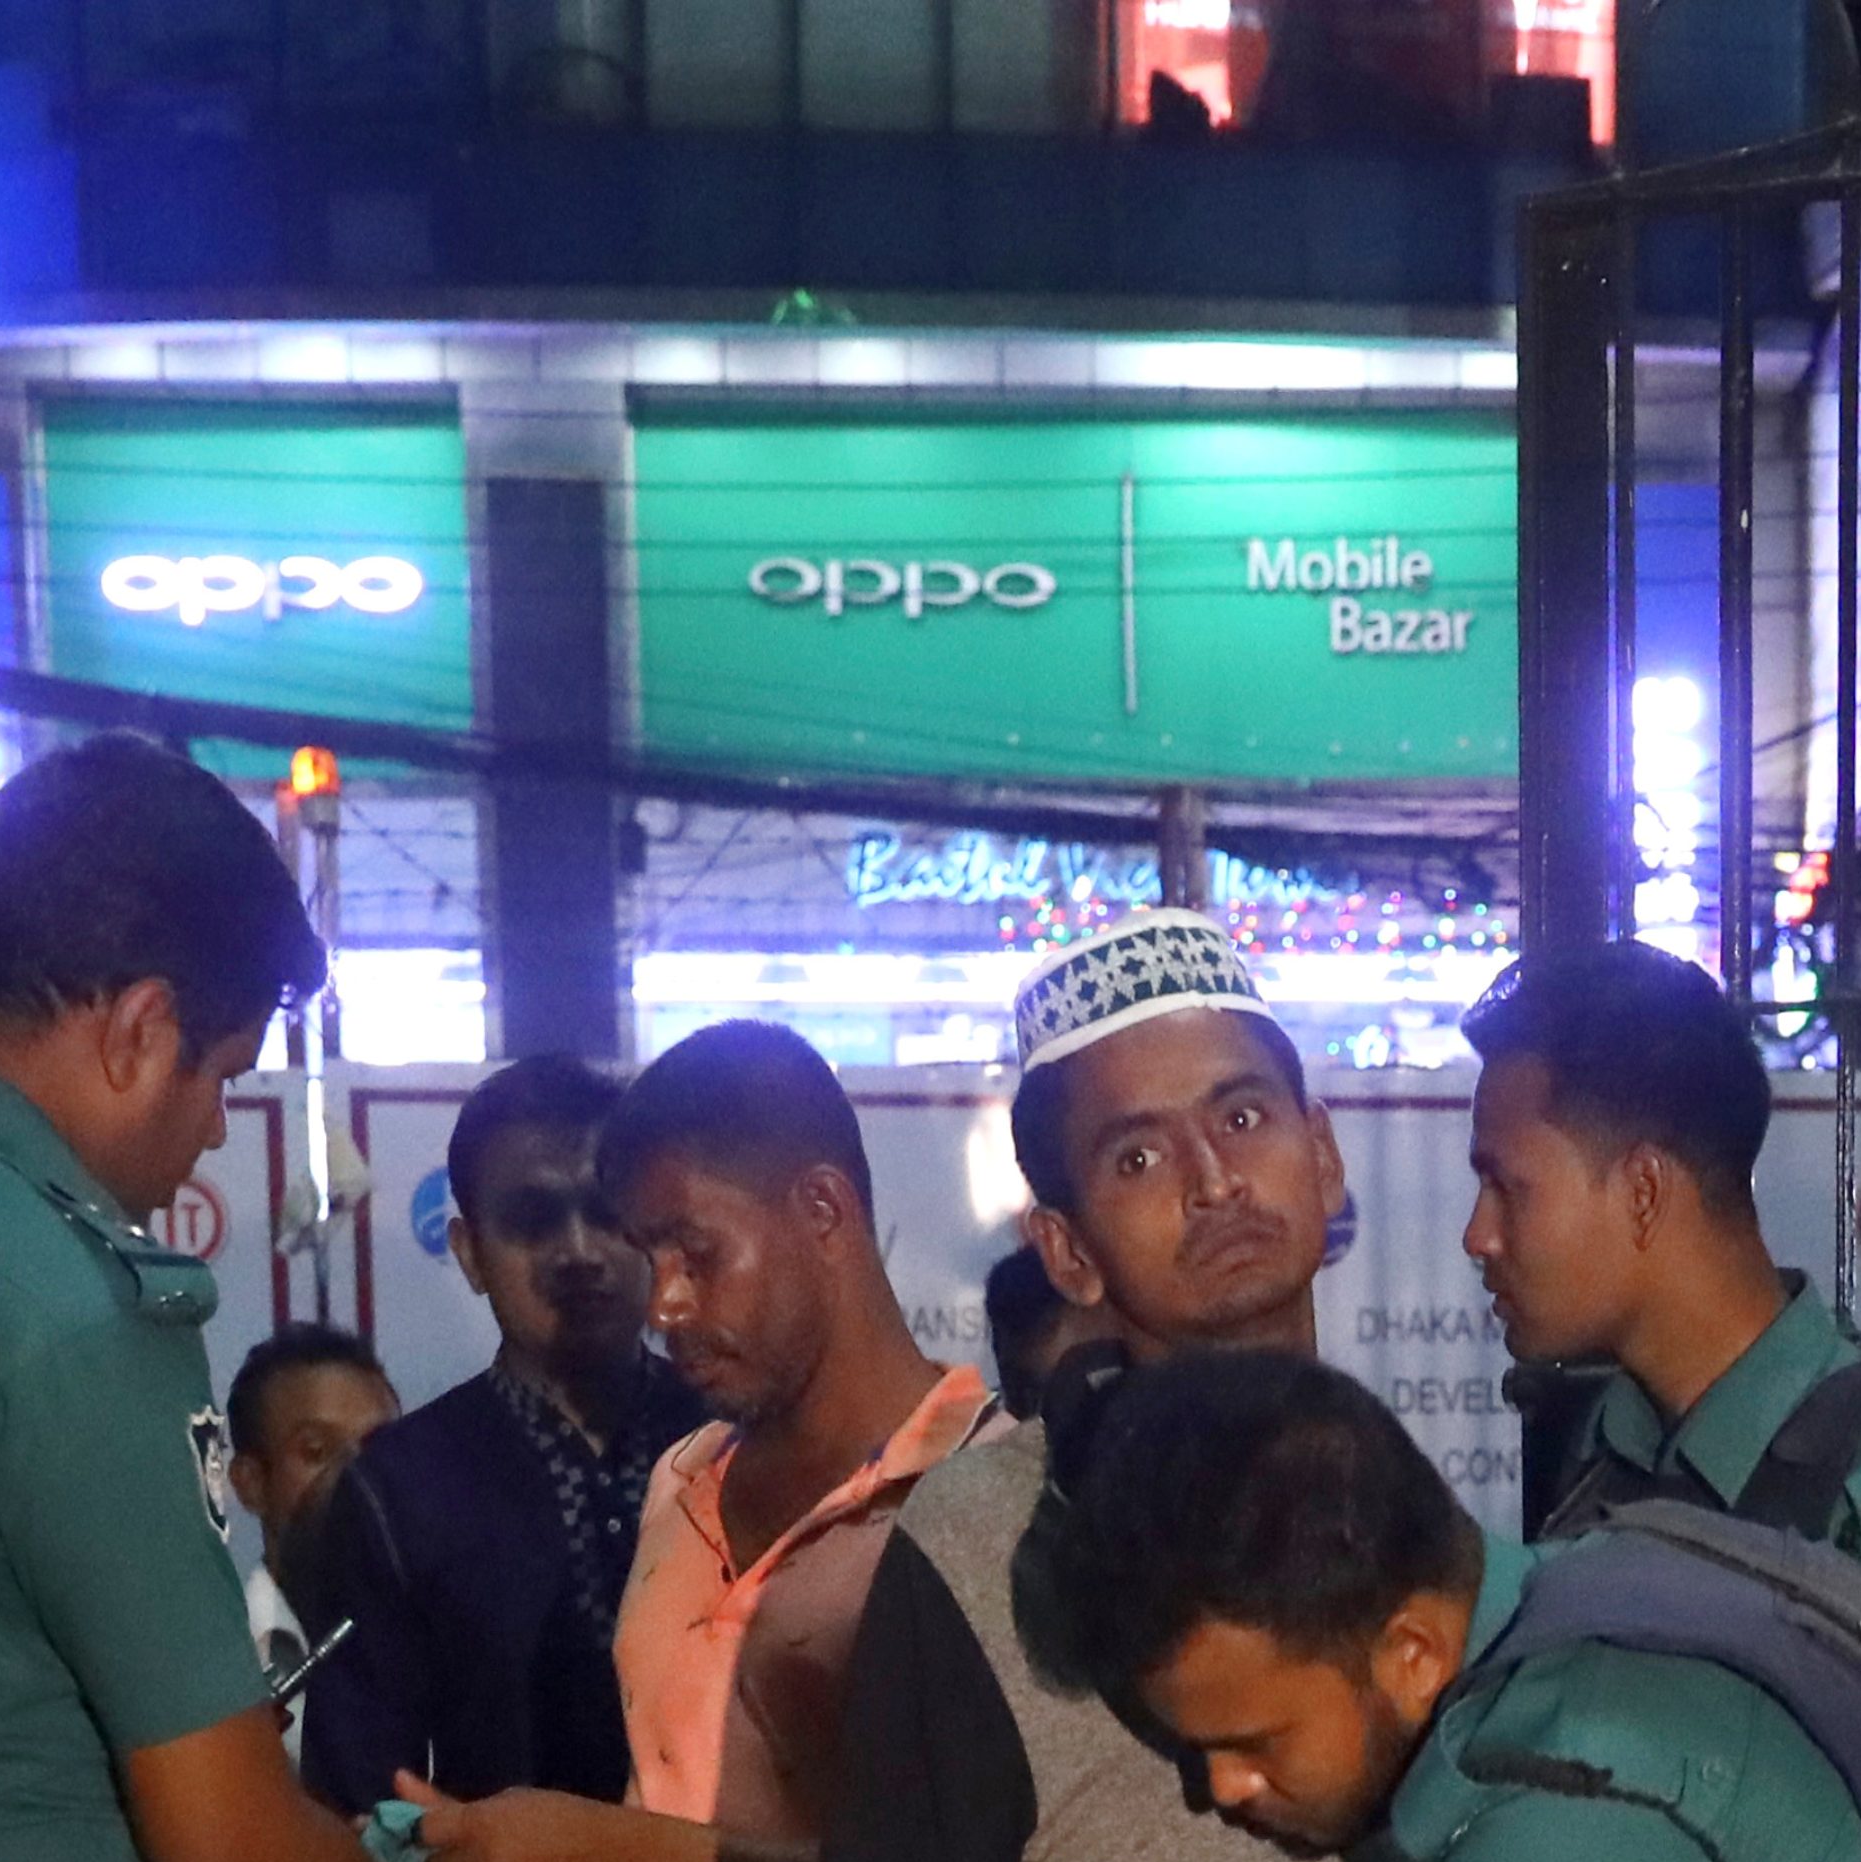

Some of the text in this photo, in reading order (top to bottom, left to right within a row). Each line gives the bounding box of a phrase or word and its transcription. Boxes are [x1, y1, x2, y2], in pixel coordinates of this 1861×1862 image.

[1245, 537, 1434, 593] Mobile
[1328, 598, 1473, 654] Bazar
[1357, 1306, 1472, 1343] DHAKA
[1393, 1376, 1518, 1415] DEVEL
[1442, 1448, 1522, 1486] CON
